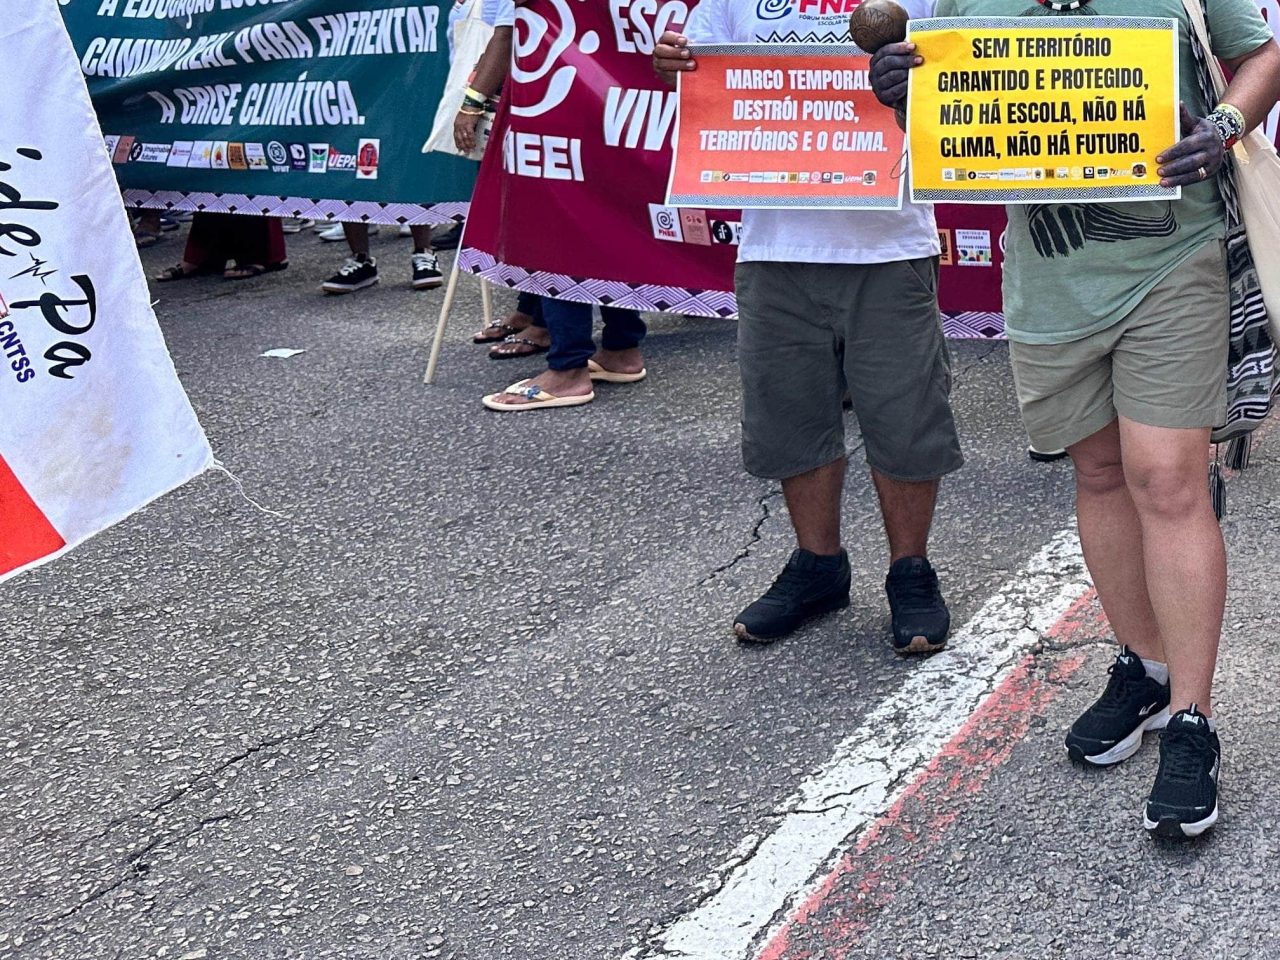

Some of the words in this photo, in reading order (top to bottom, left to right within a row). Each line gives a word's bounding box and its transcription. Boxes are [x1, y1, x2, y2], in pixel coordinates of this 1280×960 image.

[82, 37, 190, 78] CAMINHO
[176, 31, 236, 71] REAL
[234, 21, 313, 64] PARA
[308, 5, 440, 58] ENFRENTAR
[972, 37, 1010, 58] SEM
[1016, 33, 1112, 58] TERRITÓRIO
[726, 69, 784, 90] MARCO
[788, 69, 874, 91] TEMPORAL
[938, 69, 1030, 93] GARANTIDO
[1036, 69, 1045, 91] E
[1051, 67, 1149, 92] PROTEGIDO,
[149, 91, 175, 124] A
[180, 83, 243, 125] CRISE
[240, 71, 366, 126] CLIMÁTICA.
[733, 96, 798, 121] DESTRÓI
[802, 100, 859, 123] POVOS,
[940, 100, 973, 125] NÃO
[979, 97, 1001, 125] HÁ
[1007, 101, 1077, 126] ESCOLA,
[1083, 95, 1117, 122] NÃO
[1124, 95, 1146, 122] HÁ
[603, 86, 680, 151] VIV
[699, 126, 798, 151] TERRITÓRIOS
[802, 131, 812, 151] E
[816, 131, 828, 151] O
[832, 131, 888, 152] CLIMA.
[940, 136, 1001, 159] CLIMA,
[1007, 130, 1041, 156] NÃO
[1048, 129, 1068, 155] HÁ
[1076, 132, 1145, 154] FUTURO.
[328, 153, 357, 168] UEPA
